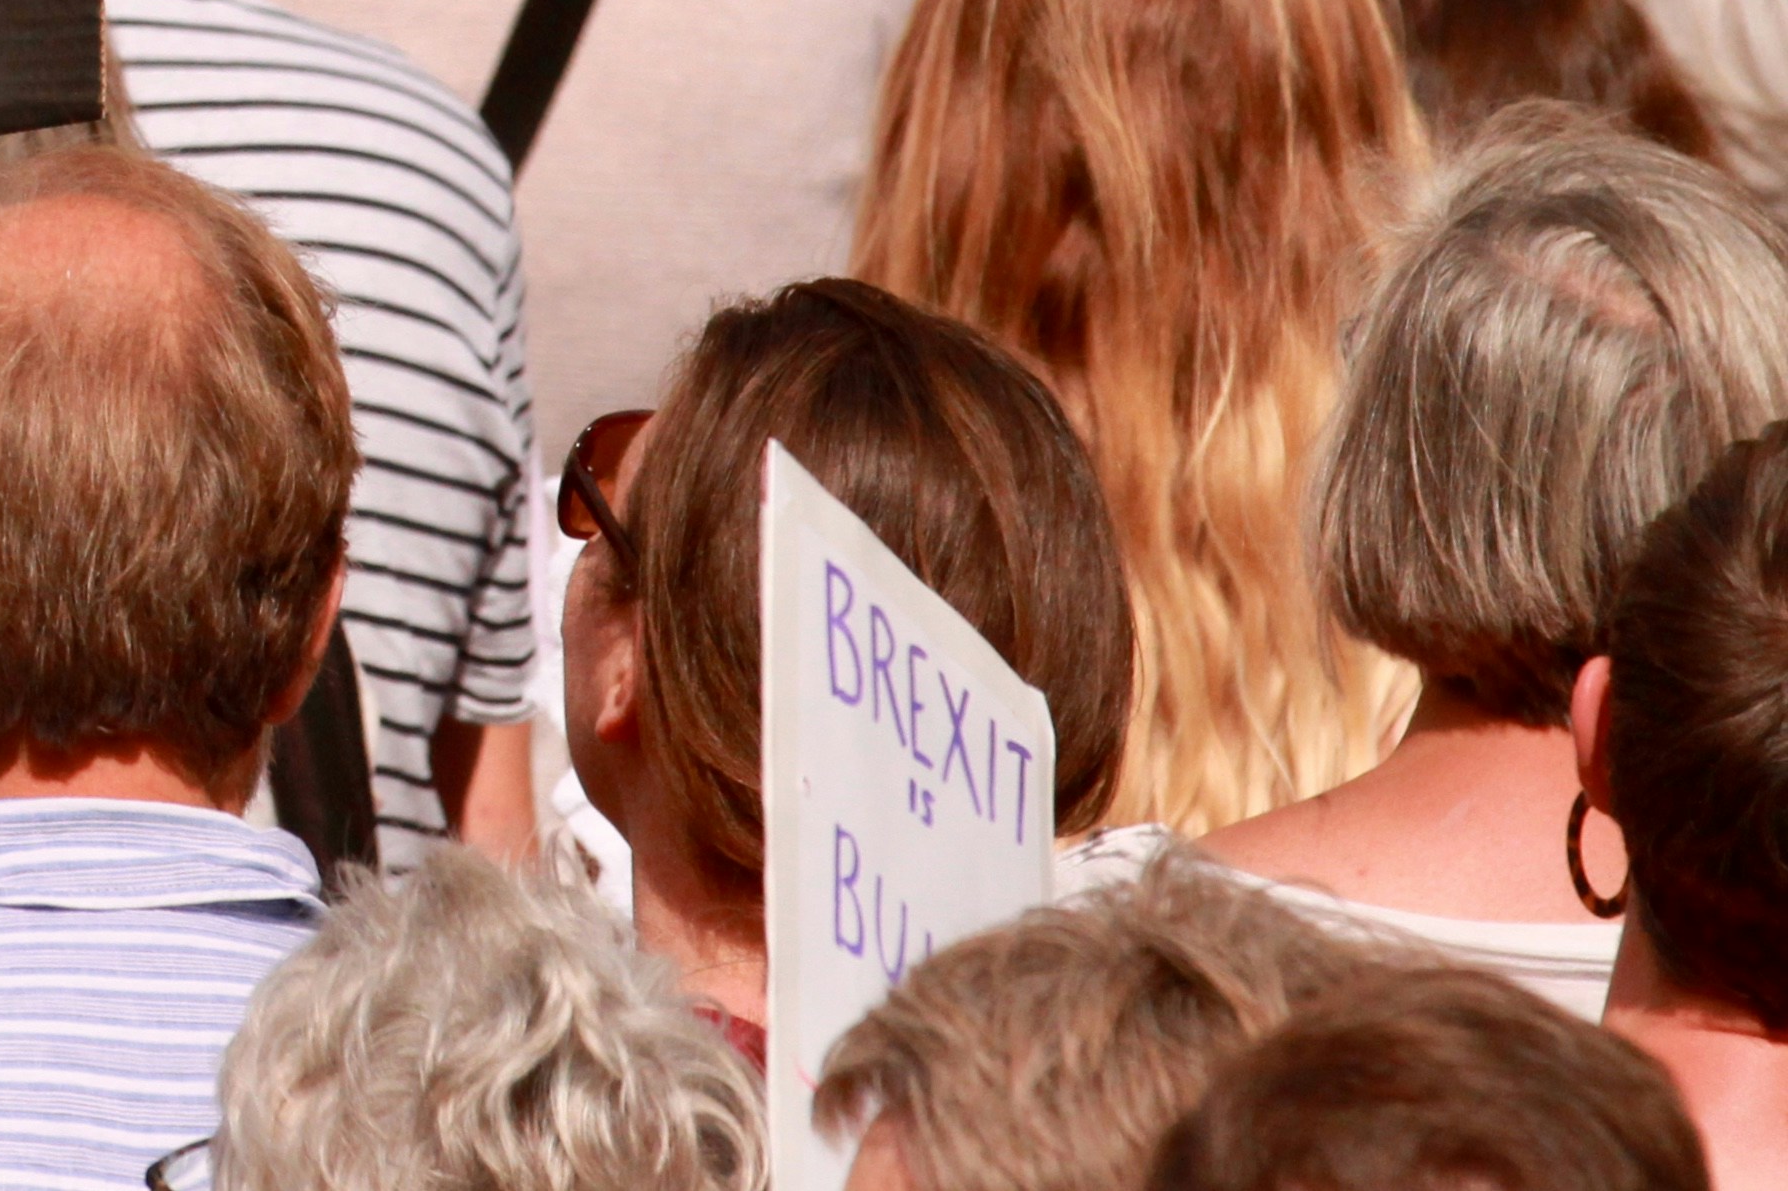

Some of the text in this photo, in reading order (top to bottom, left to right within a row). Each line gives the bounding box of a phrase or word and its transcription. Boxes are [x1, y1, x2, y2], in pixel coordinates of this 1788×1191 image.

[825, 559, 1033, 845] BREXIT
[908, 778, 934, 827] IS
[834, 823, 934, 986] BU
